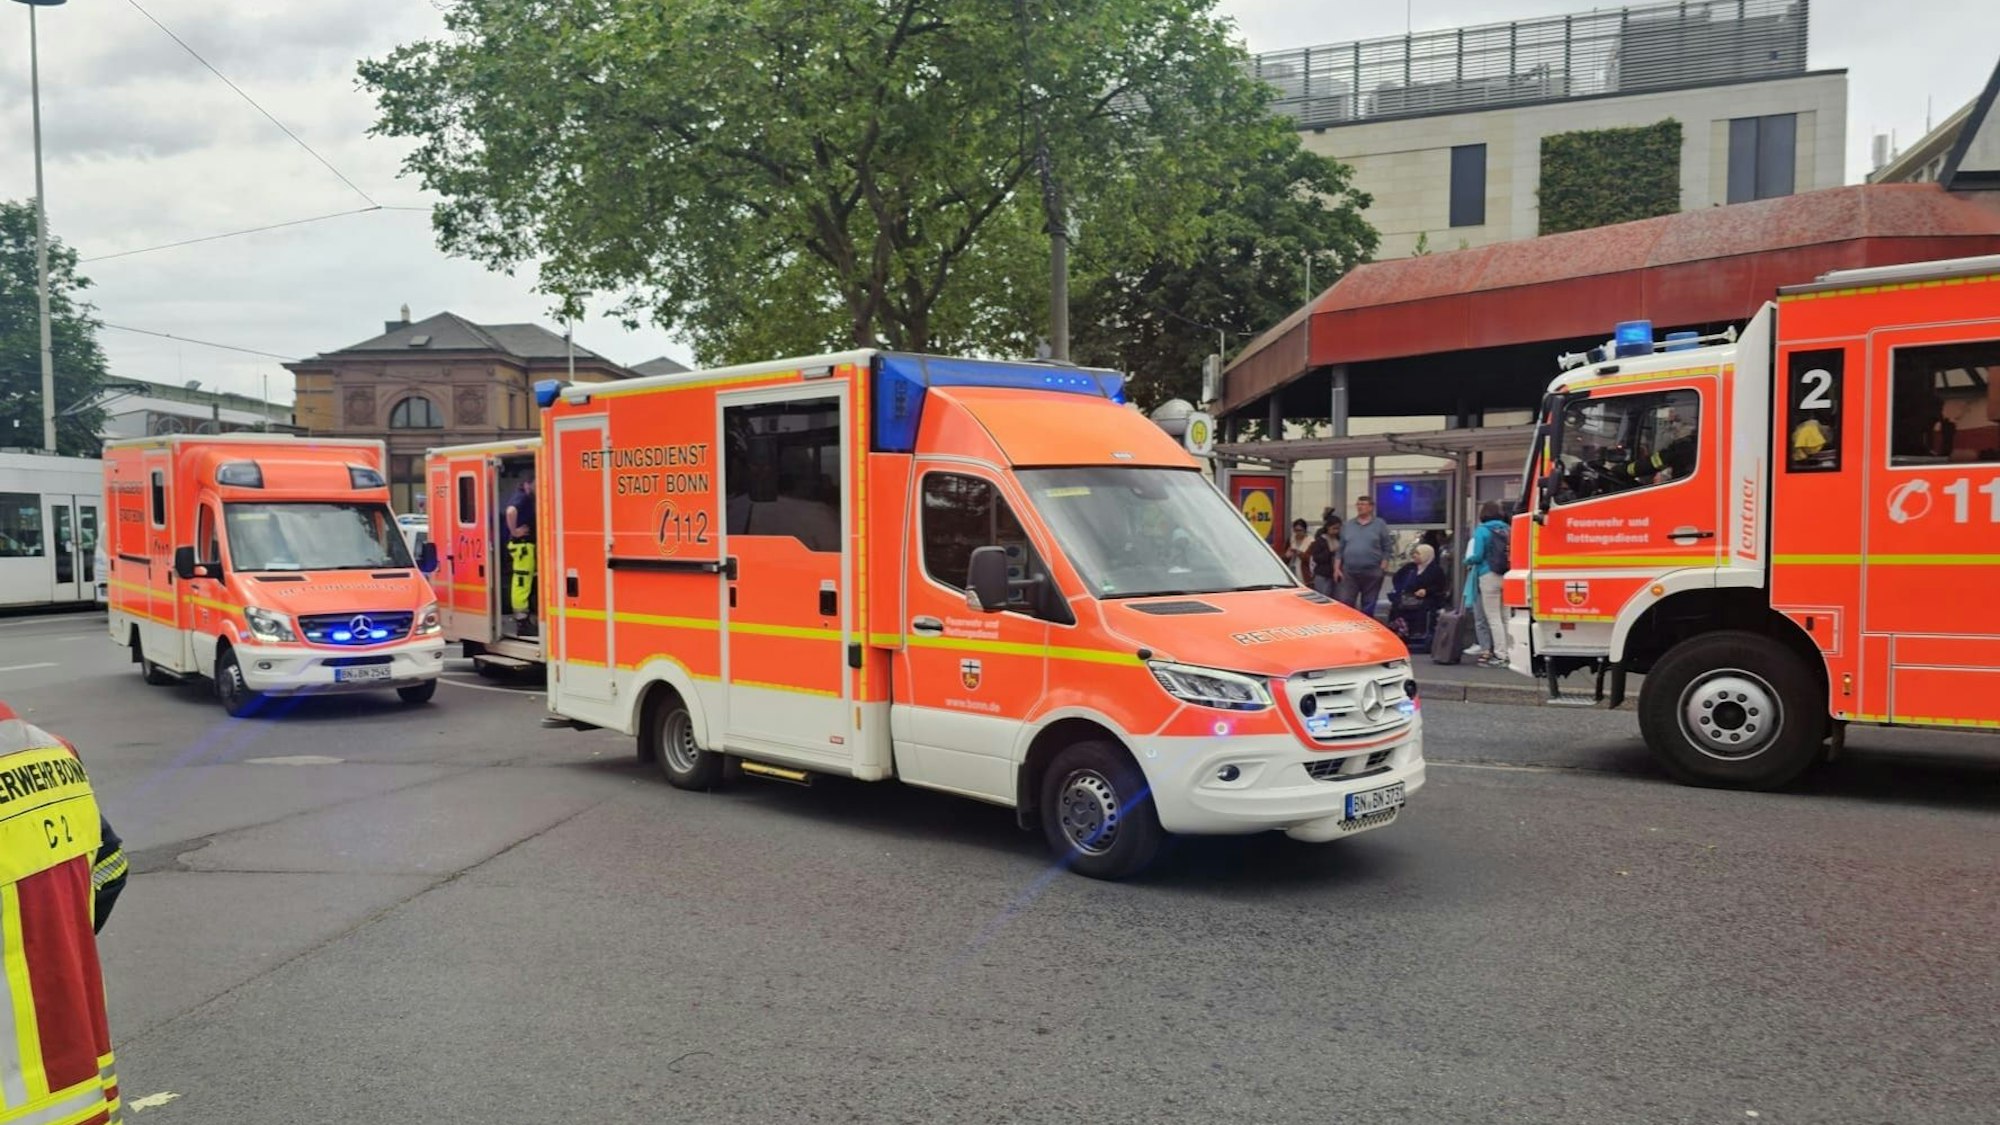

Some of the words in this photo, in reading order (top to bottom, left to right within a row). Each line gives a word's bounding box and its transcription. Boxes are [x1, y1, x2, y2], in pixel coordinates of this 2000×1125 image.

[1799, 368, 1832, 410] 2
[581, 444, 707, 470] RETTUNGSDIENST
[617, 474, 660, 494] STADT
[666, 473, 709, 493] BONN
[674, 511, 708, 543] 112
[1566, 518, 1624, 528] Feuerwehr
[1628, 517, 1649, 527] und
[1566, 533, 1649, 545] Rettungsdienst
[44, 819, 58, 849] C
